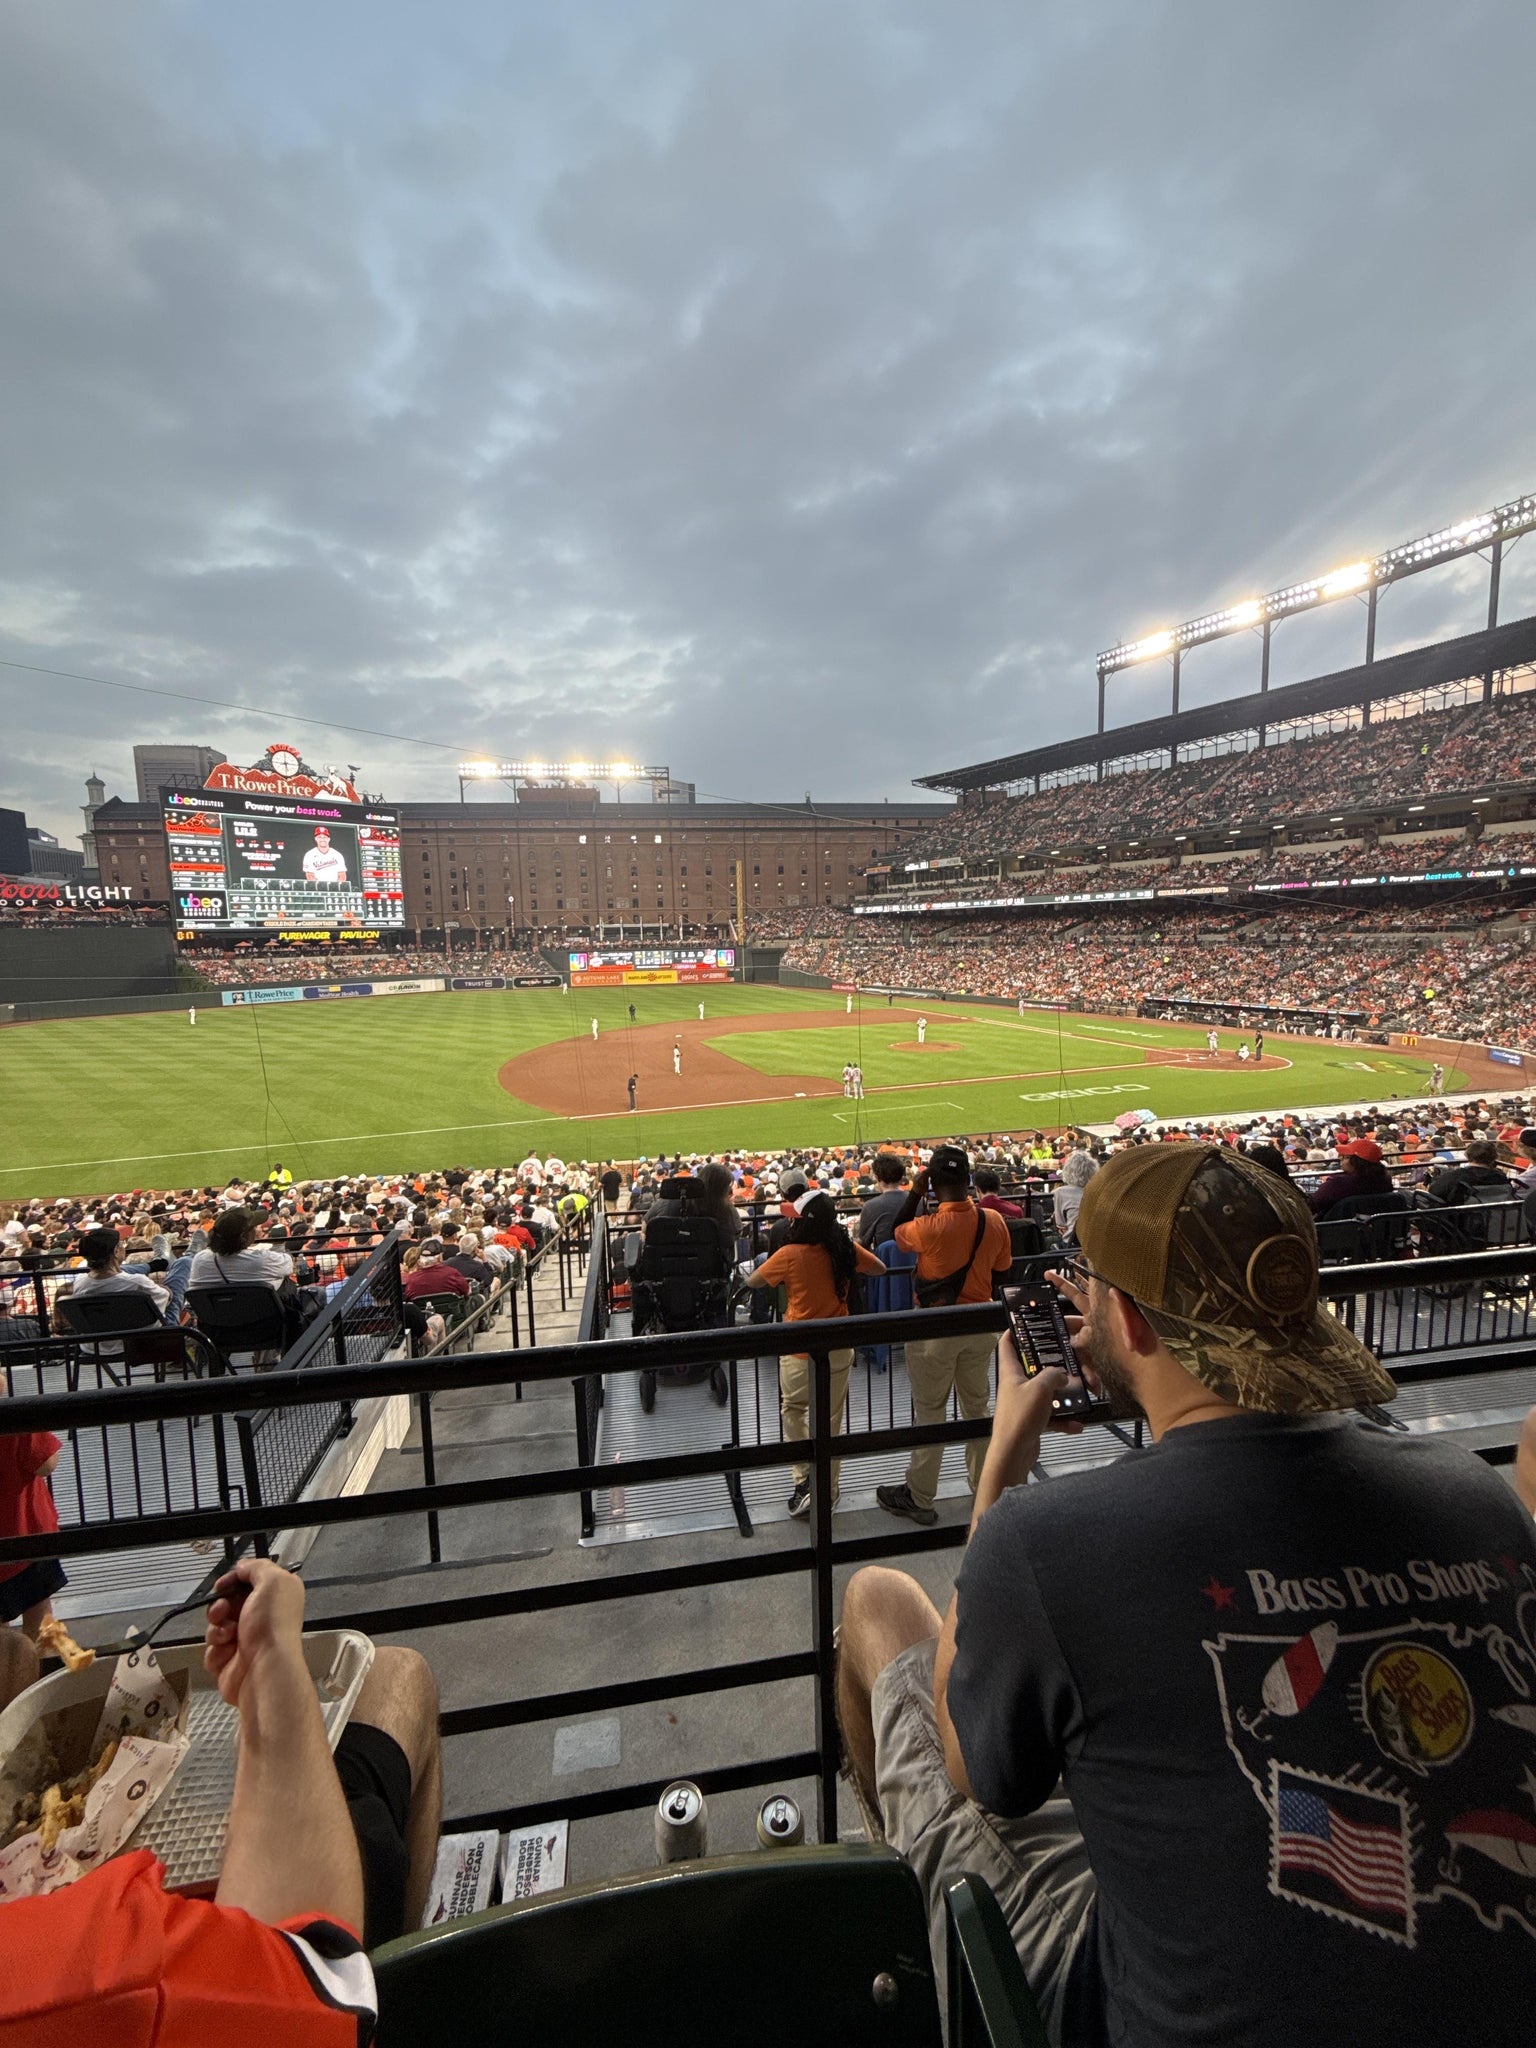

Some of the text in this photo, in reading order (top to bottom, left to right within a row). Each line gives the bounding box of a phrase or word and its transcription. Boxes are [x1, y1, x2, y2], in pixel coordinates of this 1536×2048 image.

[168, 793, 199, 806] ubeo
[245, 801, 341, 818] Power your best work.
[0, 875, 132, 900] oors LIGHT
[1389, 874, 1408, 884] Power
[1408, 873, 1425, 884] your
[1425, 872, 1441, 881] best
[180, 893, 222, 908] ubeo
[279, 930, 380, 940] PUREWAGER PAVILION
[1019, 1084, 1151, 1101] GEICO
[1246, 1559, 1502, 1615] Bass Pro Shops
[1379, 1653, 1421, 1694] Bass
[515, 1839, 528, 1898] BOBBLECA
[523, 1837, 535, 1897] HENDERSO
[532, 1836, 543, 1882] GUNNAR
[457, 1848, 476, 1917] ENDERSON
[465, 1841, 485, 1914] OBBLECARD
